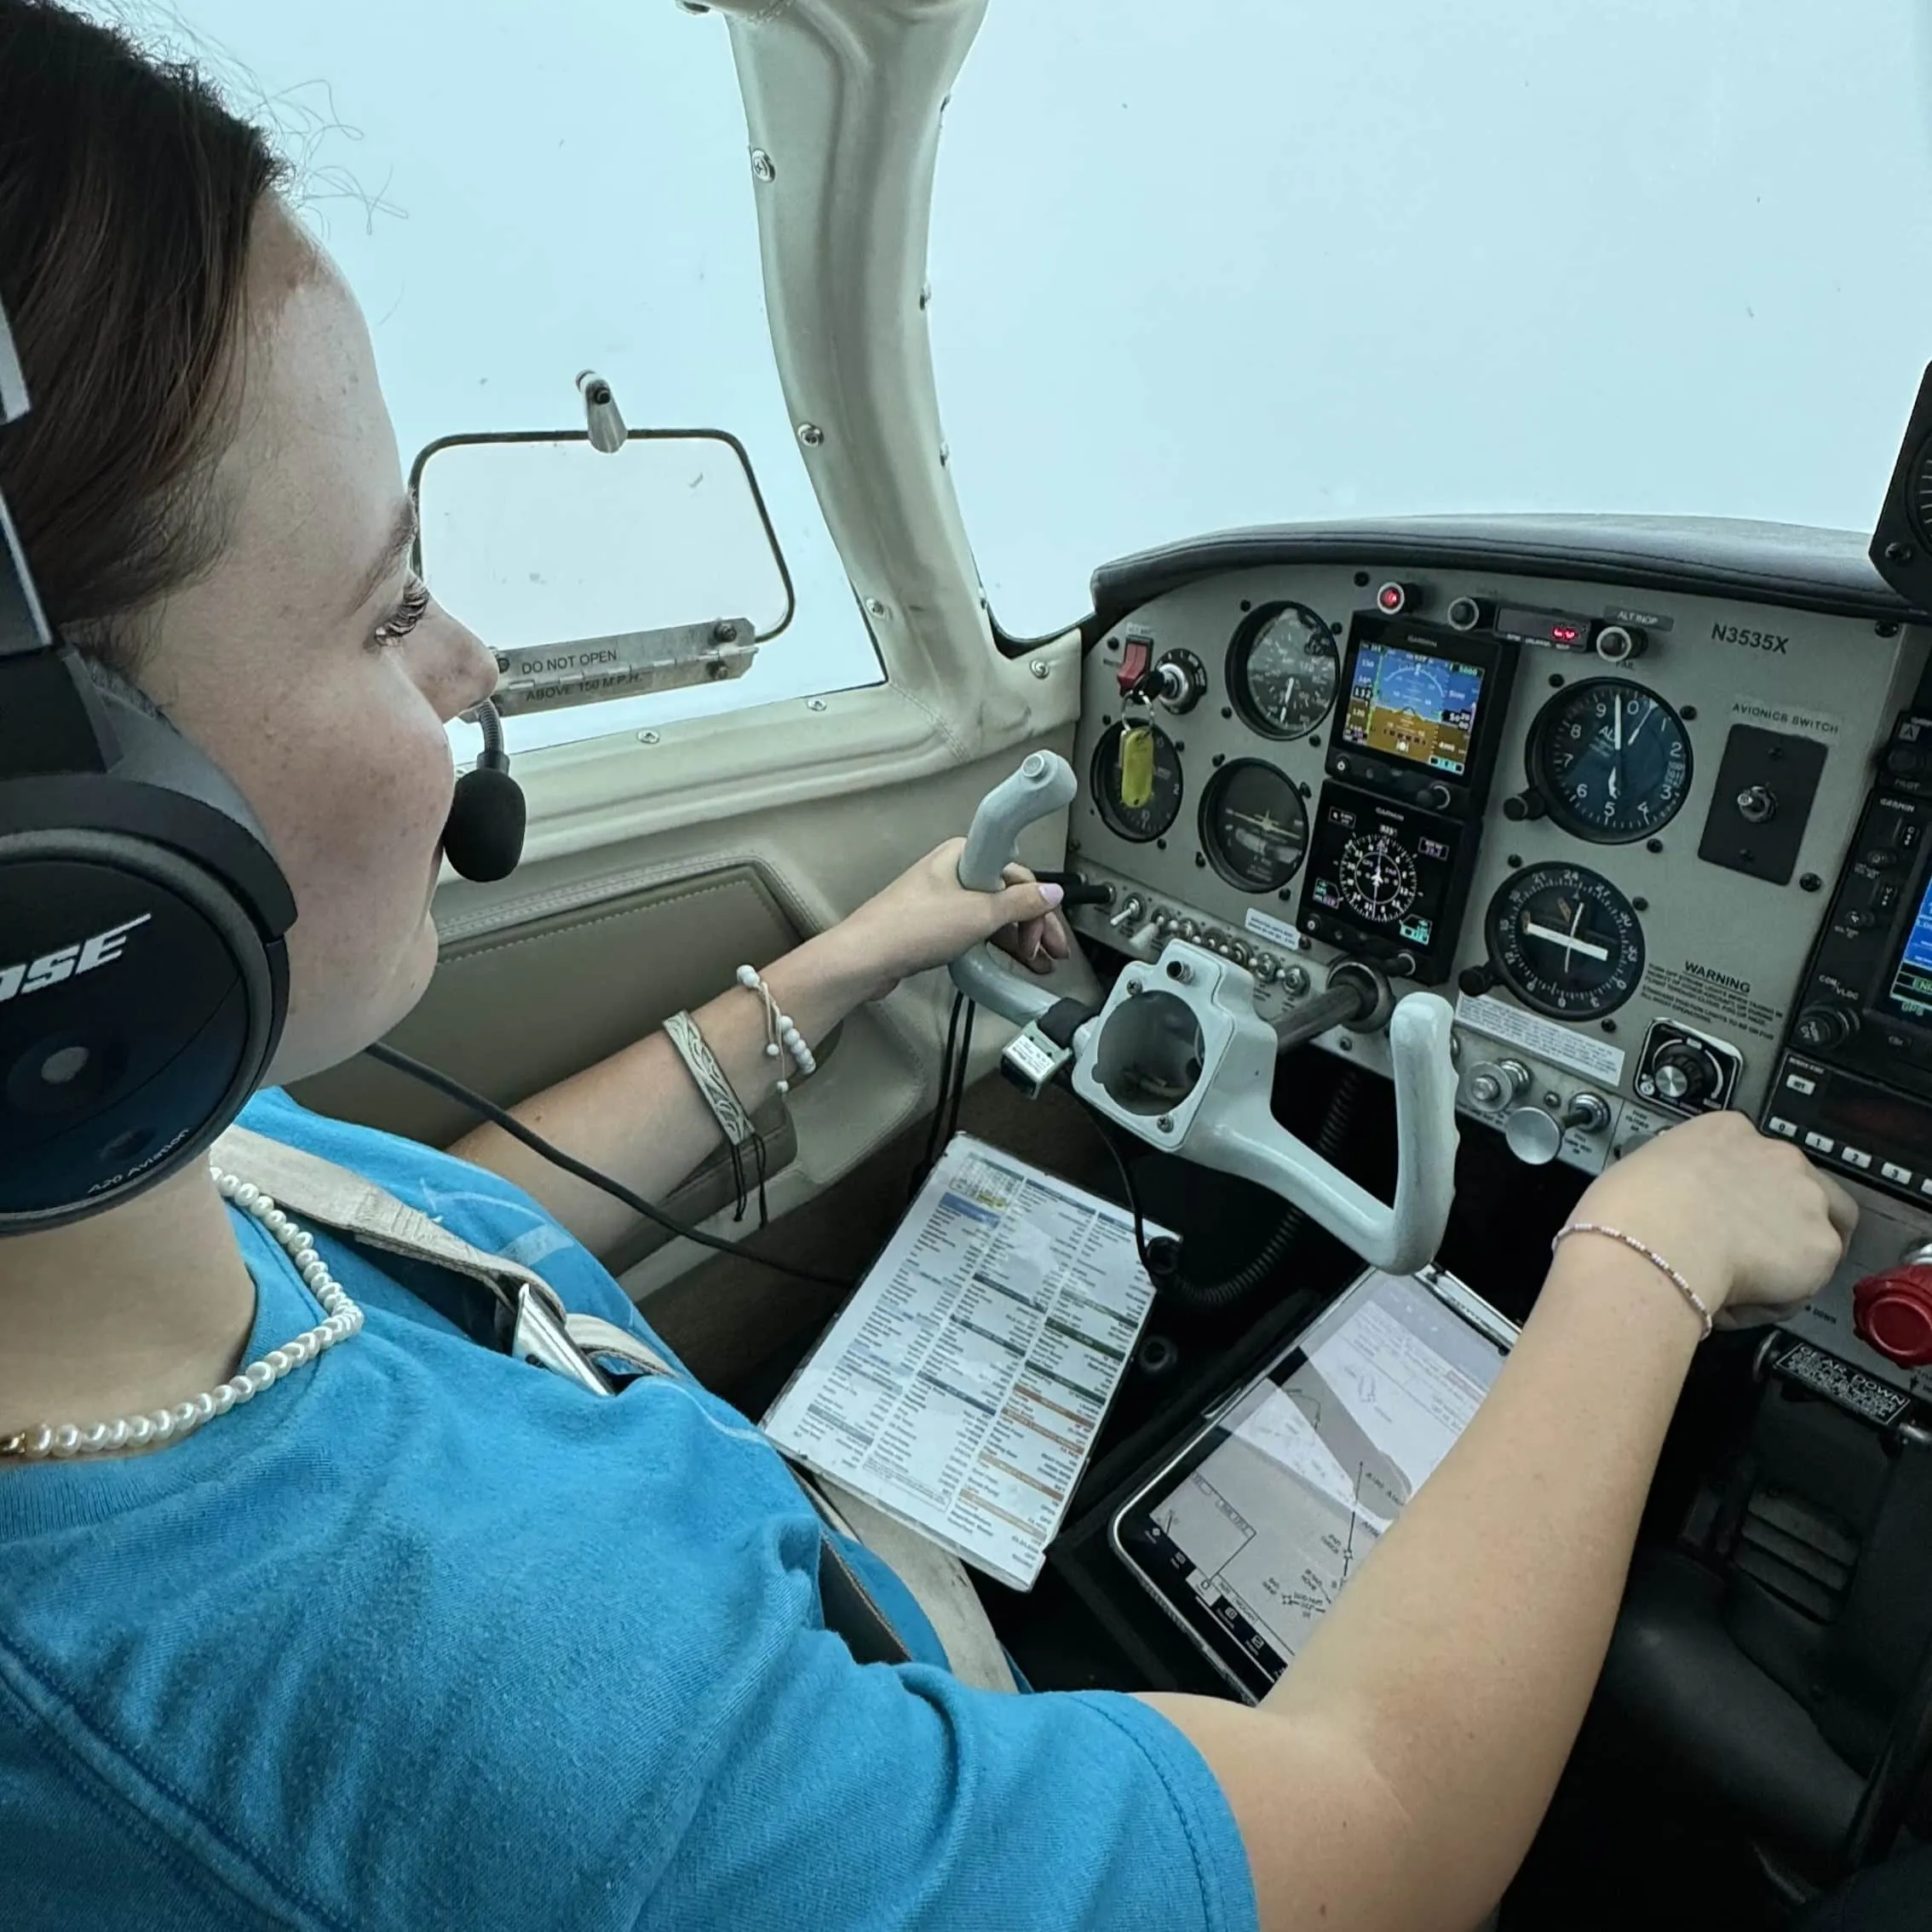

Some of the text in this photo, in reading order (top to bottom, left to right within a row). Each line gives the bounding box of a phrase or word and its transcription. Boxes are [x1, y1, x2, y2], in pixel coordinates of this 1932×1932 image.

[1618, 611, 1659, 624] ALT INOP
[1711, 624, 1789, 654] N3535X
[522, 650, 617, 675] DO NOT OPEN
[526, 684, 574, 702] ABOVE
[1596, 704, 1607, 718] 9
[1627, 700, 1639, 715] 0
[1733, 703, 1838, 733] AVIONICS SWITCH
[1570, 725, 1582, 739] 8
[1599, 726, 1615, 741] AL
[1670, 742, 1682, 757] 2
[1564, 753, 1574, 768] 7
[1577, 783, 1589, 798] 6
[1660, 784, 1671, 800] 3
[1604, 802, 1616, 817] 5
[1637, 801, 1649, 816] 4
[1563, 870, 1578, 881] 24
[0, 912, 152, 1002] SE
[1627, 945, 1637, 962] 33
[1685, 960, 1751, 993] WARNING
[87, 1129, 189, 1193] A20 Aviation
[1852, 1153, 1859, 1162] 2
[1891, 1170, 1899, 1178] 3
[1852, 1374, 1906, 1406] DOWN
